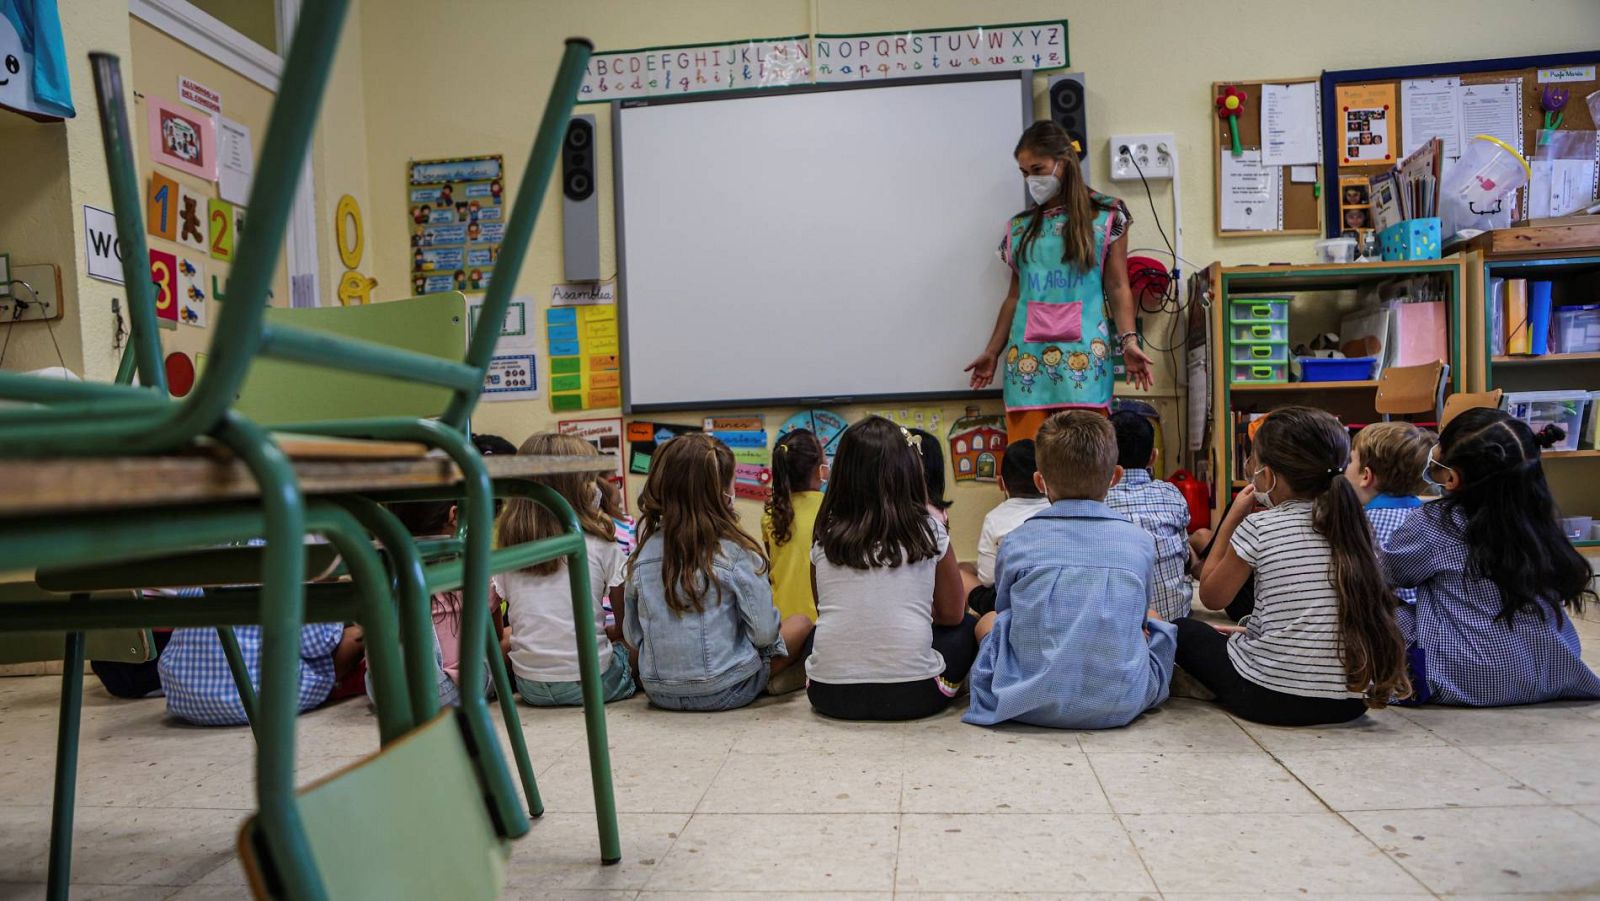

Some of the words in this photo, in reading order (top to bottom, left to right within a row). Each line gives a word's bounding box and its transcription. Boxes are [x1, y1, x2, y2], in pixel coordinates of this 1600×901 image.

[597, 60, 608, 76] B
[613, 58, 624, 74] C
[630, 56, 640, 72] D
[646, 55, 656, 72] E
[662, 54, 672, 70] F
[678, 52, 690, 69] G
[695, 50, 706, 68] H
[712, 50, 721, 66] I
[726, 48, 736, 65] J
[742, 47, 752, 64] K
[757, 47, 766, 62] L
[838, 42, 852, 58] O
[859, 40, 870, 56] P
[876, 40, 890, 57] Q
[896, 38, 908, 54] R
[912, 36, 923, 54] S
[928, 36, 942, 52] T
[948, 34, 961, 52] U
[967, 34, 980, 50] V
[988, 32, 1004, 49] W
[1012, 30, 1024, 48] X
[1031, 30, 1042, 46] Y
[1048, 28, 1058, 45] Z
[154, 184, 168, 233] 1
[90, 228, 123, 263] W
[212, 209, 229, 256] 2
[152, 260, 172, 310] 3
[552, 288, 613, 300] Asamblea
